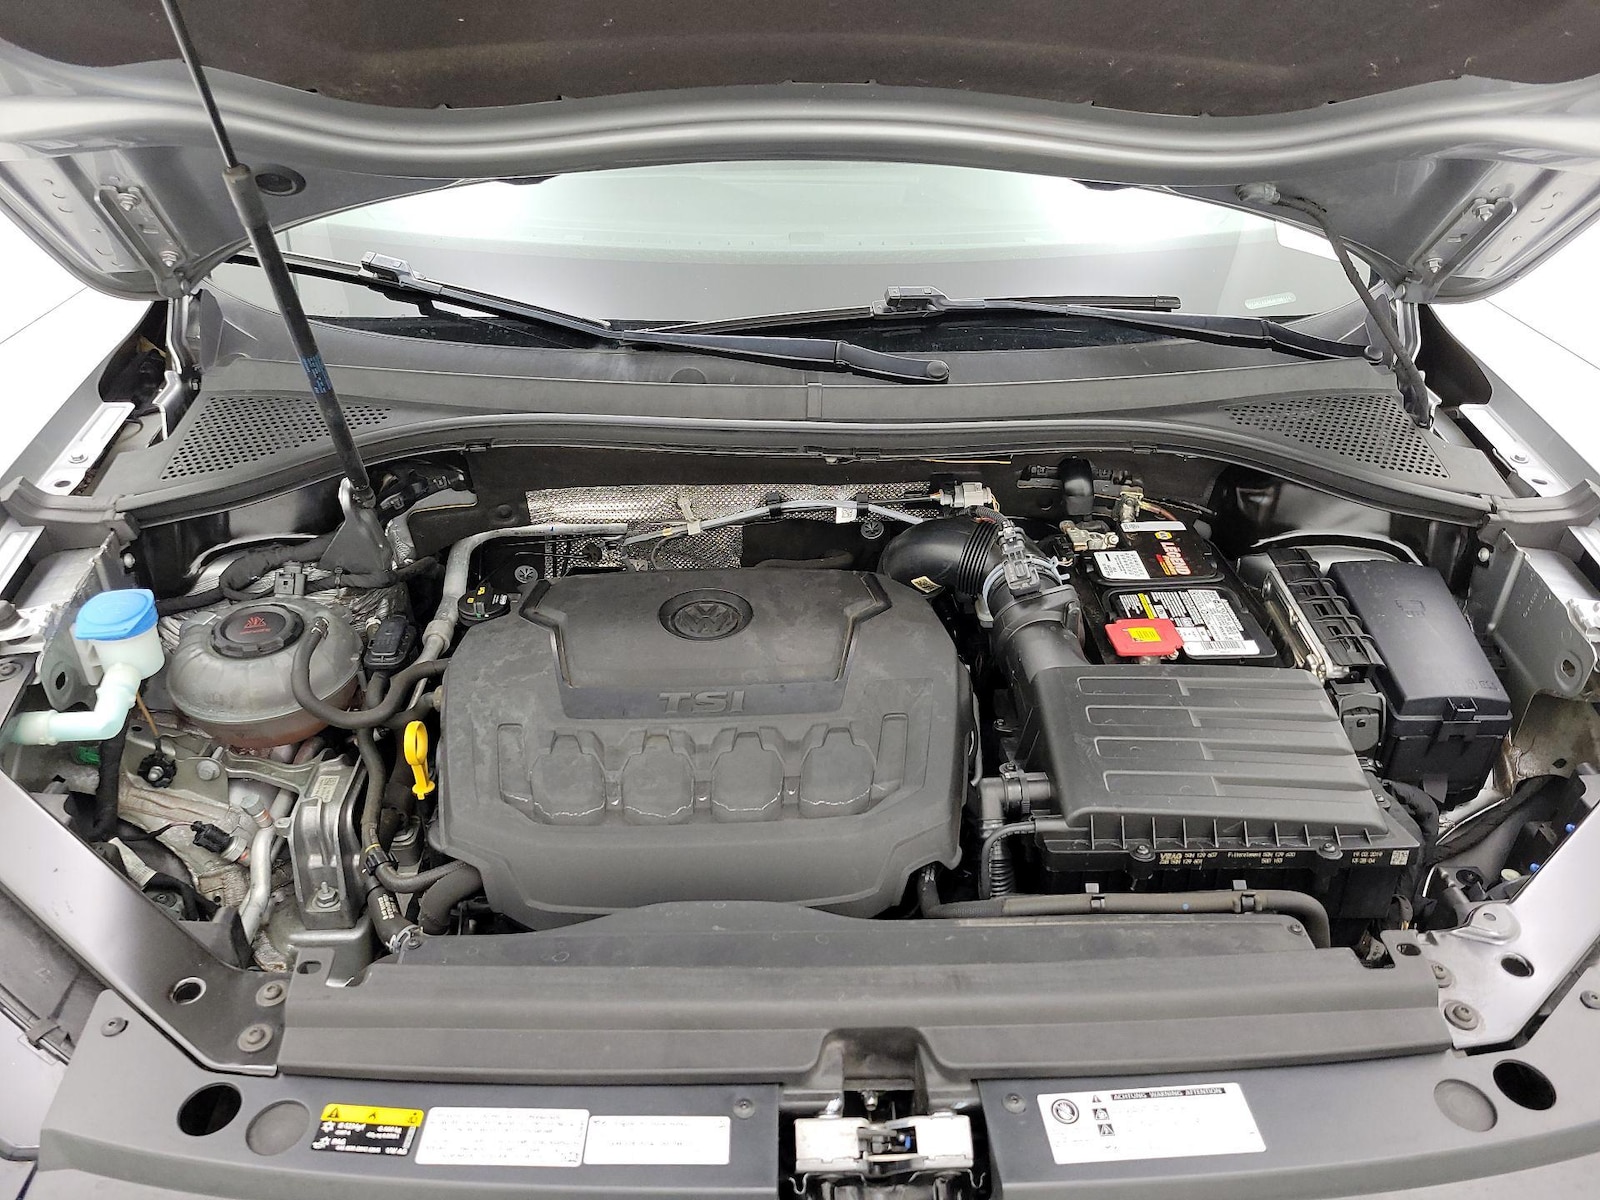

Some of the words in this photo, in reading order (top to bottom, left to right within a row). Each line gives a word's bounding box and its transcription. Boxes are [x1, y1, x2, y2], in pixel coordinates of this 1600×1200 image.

[658, 690, 745, 713] TSI
[1113, 1092, 1147, 1101] ACHTUNG
[1149, 1090, 1182, 1099] WARNING
[1185, 1087, 1222, 1097] ATTENTION
